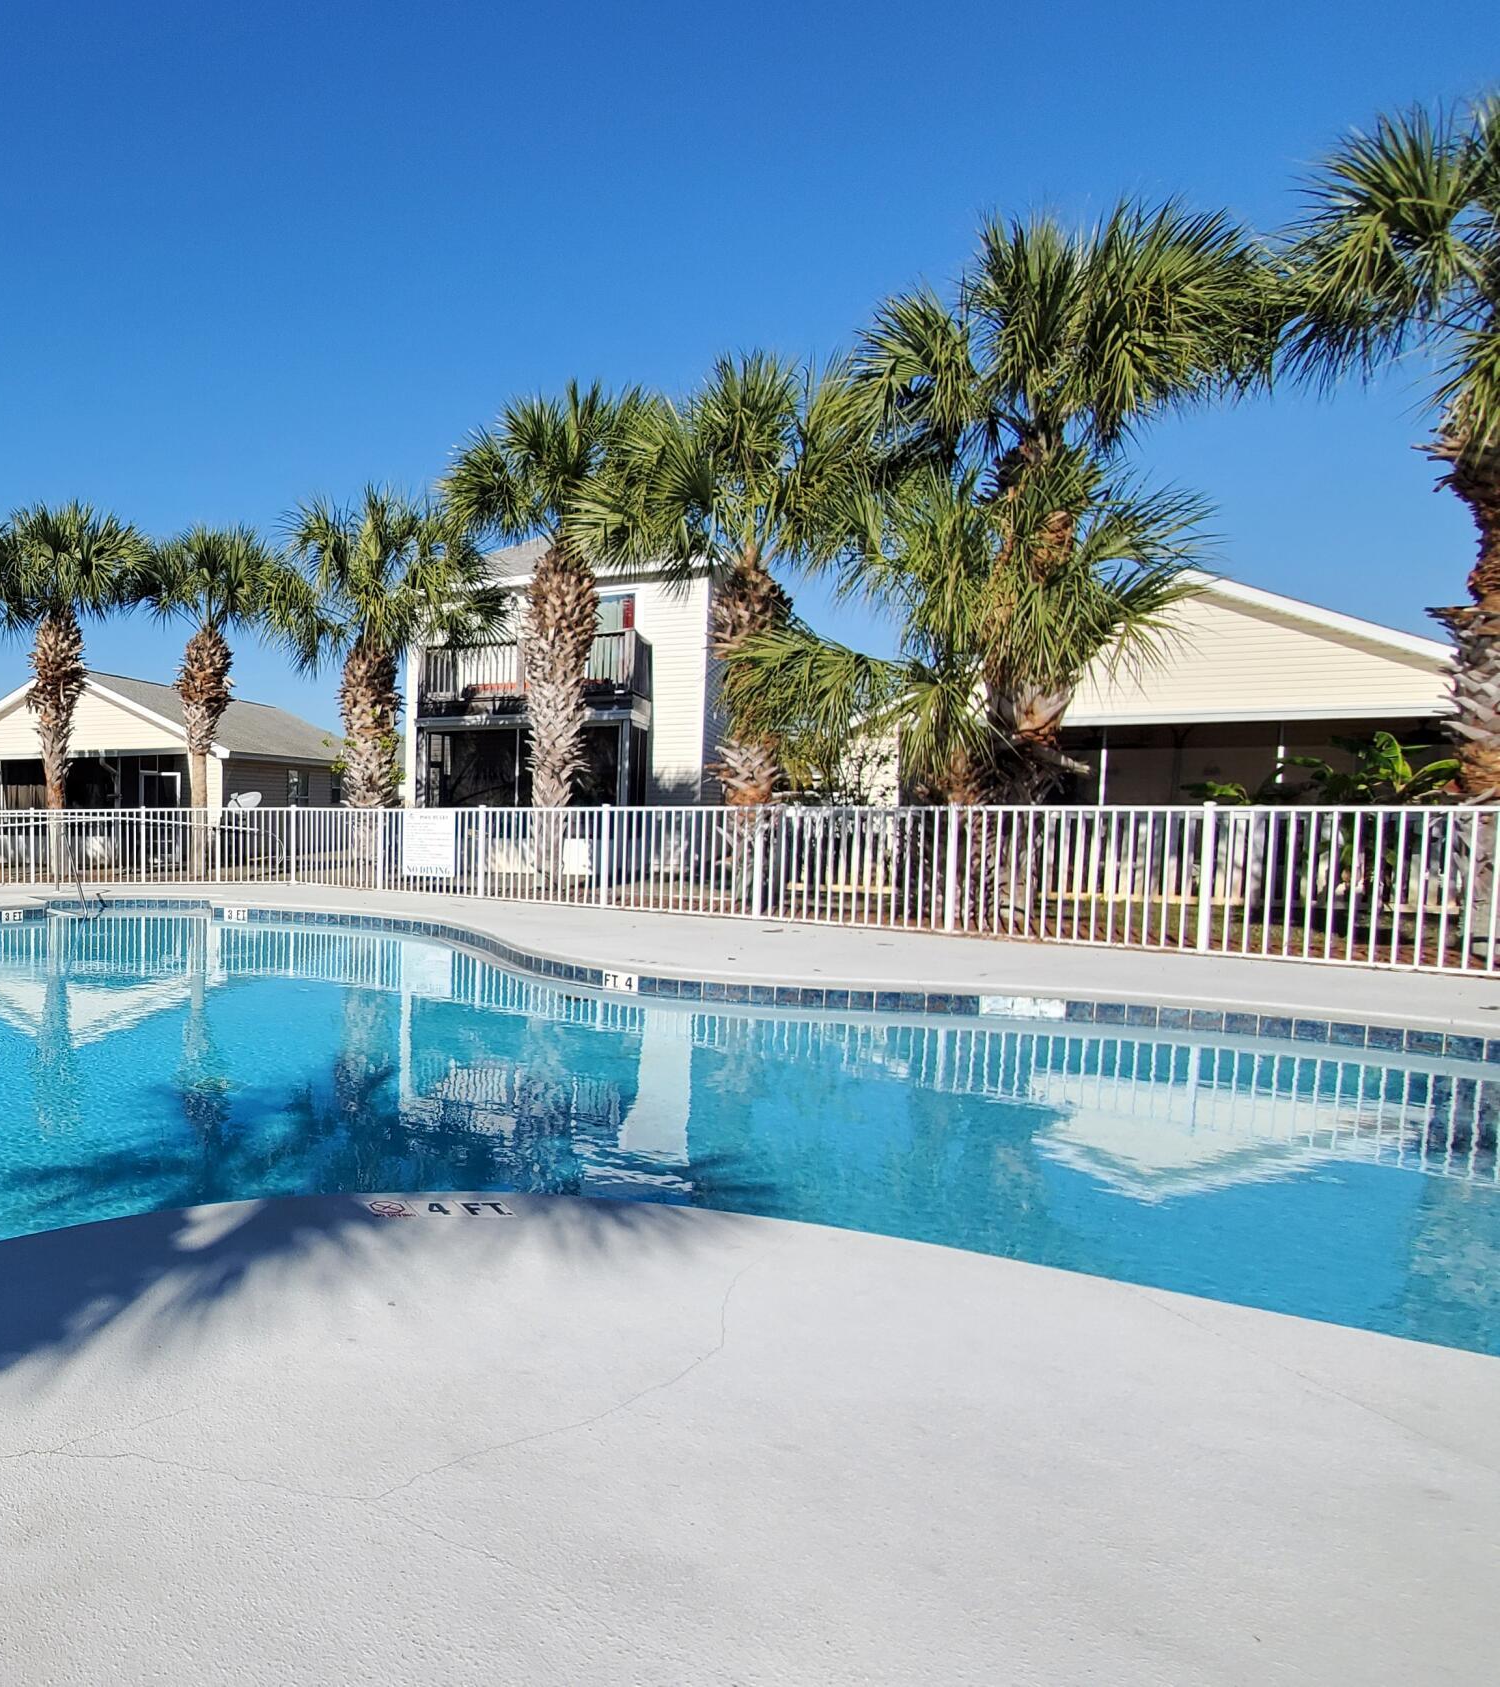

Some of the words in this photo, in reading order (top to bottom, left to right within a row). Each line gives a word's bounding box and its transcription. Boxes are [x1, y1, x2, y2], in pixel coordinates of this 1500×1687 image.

[406, 865, 418, 873] NO
[419, 865, 451, 875] DIVING
[625, 976, 633, 990] 4
[427, 1202, 452, 1215] 4
